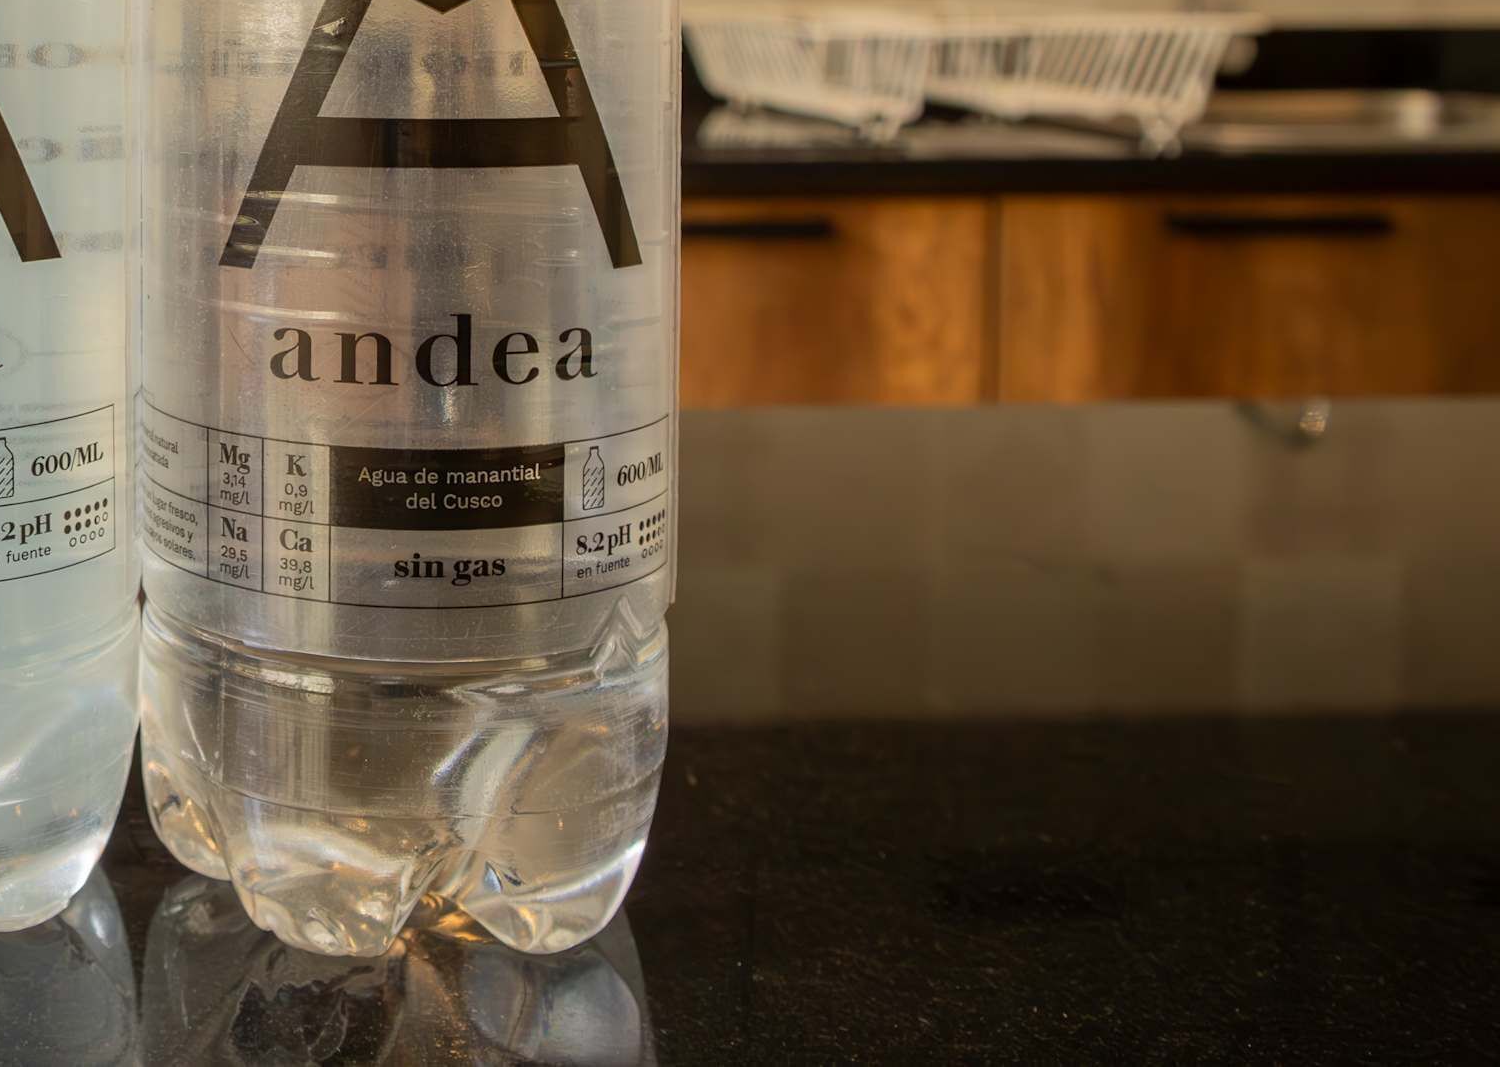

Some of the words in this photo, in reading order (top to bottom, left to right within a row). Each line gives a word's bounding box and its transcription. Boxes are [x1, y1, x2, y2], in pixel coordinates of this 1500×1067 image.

[269, 313, 599, 388] andea
[31, 441, 104, 477] 600/ML
[219, 442, 251, 475] Mg
[285, 453, 307, 477] K
[223, 472, 246, 488] 3,14
[357, 466, 408, 487] Agua
[414, 467, 439, 484] de
[446, 463, 541, 484] manantial
[219, 489, 250, 506] mg/l
[284, 483, 308, 498] 0,9
[279, 500, 314, 516] mg/l
[405, 492, 437, 510] del
[443, 493, 503, 510] Cusco
[187, 530, 194, 543] y
[220, 516, 249, 542] Na
[279, 528, 314, 553] Ca
[6, 546, 52, 564] fuente
[220, 545, 248, 563] 29,5
[219, 563, 250, 580] mg/l
[280, 557, 312, 575] 39,8
[394, 553, 445, 578] sin
[451, 557, 506, 587] gas
[576, 566, 592, 579] en
[596, 557, 631, 575] fuente
[279, 575, 315, 592] mg/l
